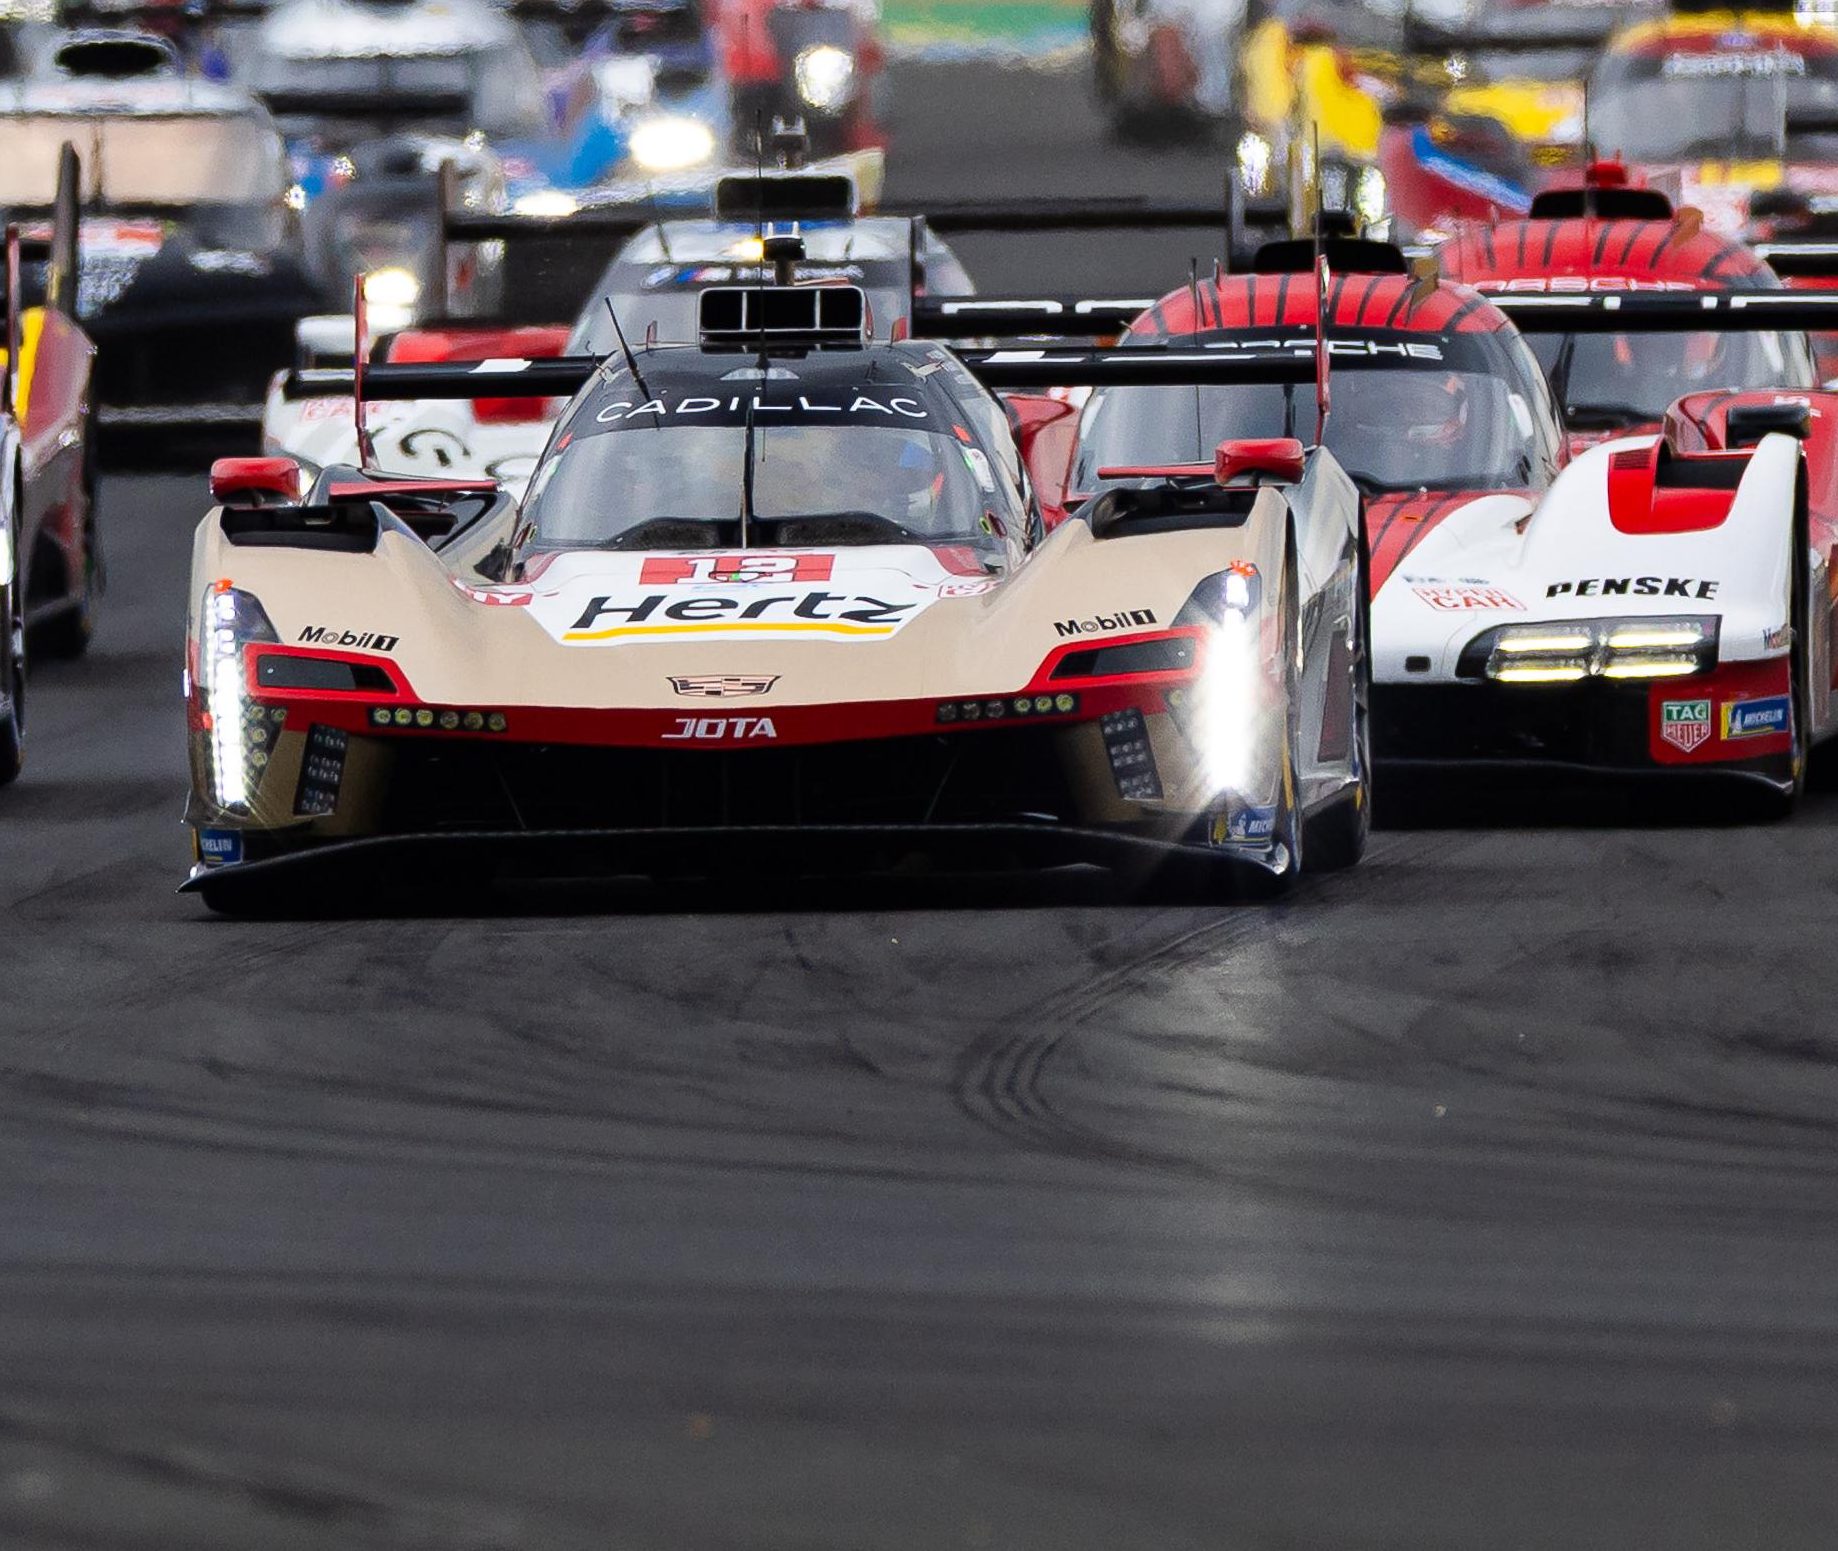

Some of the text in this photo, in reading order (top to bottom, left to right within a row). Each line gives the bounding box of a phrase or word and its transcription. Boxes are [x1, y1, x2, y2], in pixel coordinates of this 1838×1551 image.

[596, 397, 927, 423] CADILLAC
[1546, 576, 1720, 600] PENSKE
[570, 592, 917, 628] Hertz
[1053, 612, 1132, 637] Mobil
[297, 626, 375, 648] Mobil
[1666, 705, 1707, 721] TAG
[1743, 709, 1784, 726] MICHELIN
[661, 717, 777, 739] JOTA
[1666, 723, 1707, 748] HEUER
